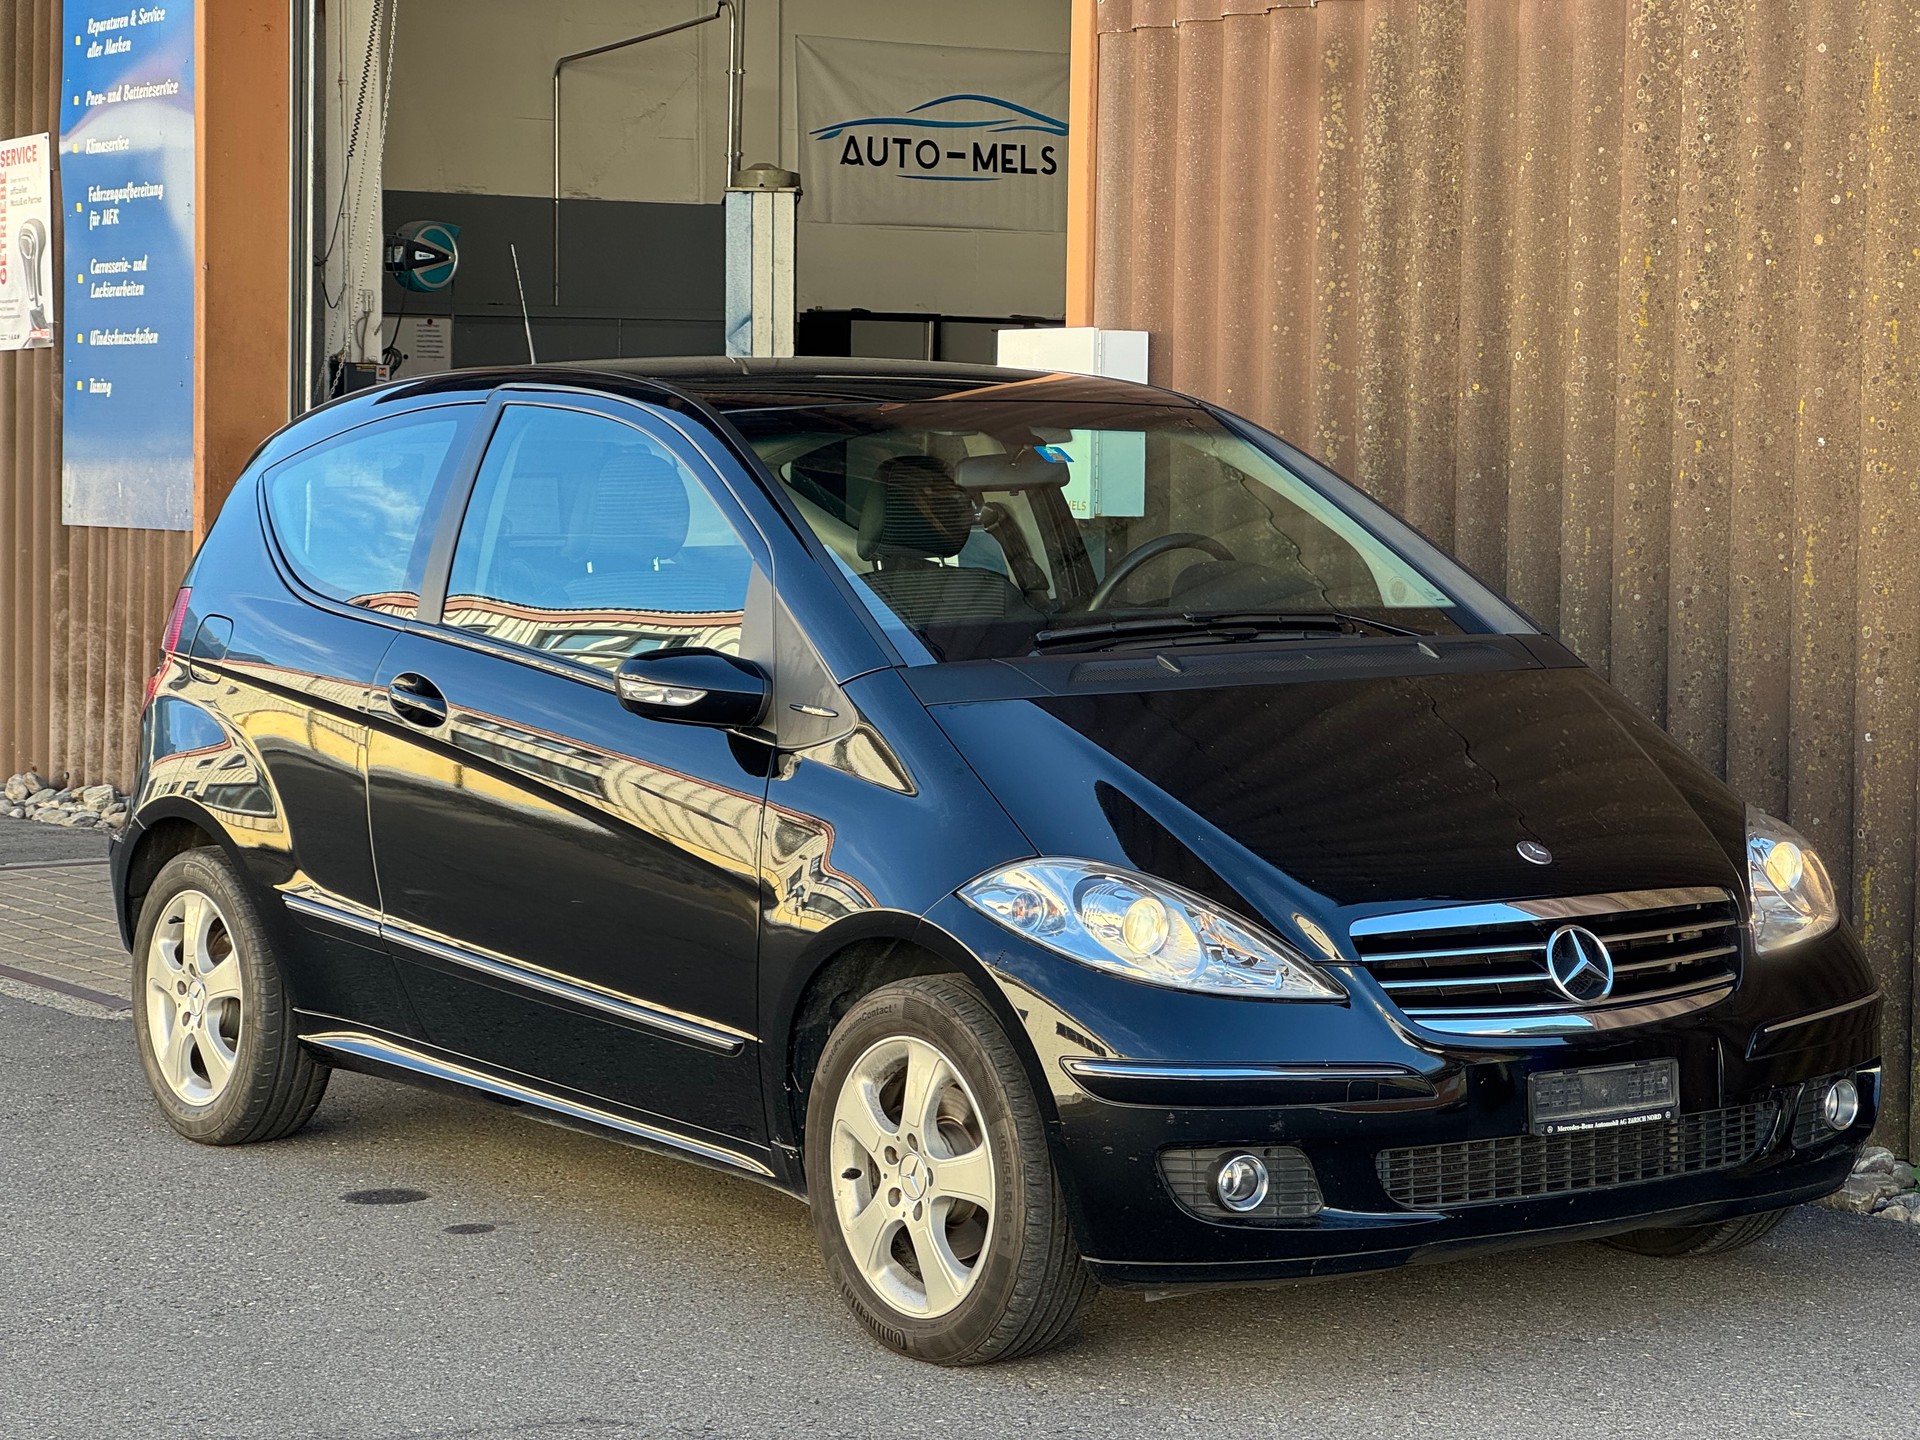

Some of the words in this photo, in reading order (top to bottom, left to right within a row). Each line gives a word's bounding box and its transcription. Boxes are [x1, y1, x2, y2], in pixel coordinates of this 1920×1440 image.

[87, 13, 129, 37] Reparaturen
[130, 9, 137, 26] &
[138, 6, 166, 25] Service
[86, 42, 103, 59] aller
[104, 36, 132, 56] Marken
[85, 90, 107, 107] Pneu-
[107, 86, 122, 104] und
[123, 79, 179, 102] Batterieservice
[0, 144, 38, 168] SERVICE
[85, 135, 130, 155] Klimaservice
[88, 181, 164, 205] Fahrzeugaufbereitung
[89, 211, 101, 231] für
[102, 208, 120, 226] MFK
[90, 258, 132, 275] Carrosserie-
[133, 254, 148, 272] und
[90, 280, 145, 299] Lackierarbeiten
[89, 327, 159, 346] Windschutzscheiben
[89, 377, 113, 398] Tuning
[1557, 1123, 1594, 1132] Mercedes-Benz
[1594, 1119, 1619, 1129] Automobil
[1619, 1118, 1628, 1126] AG
[1646, 1113, 1662, 1122] NORD
